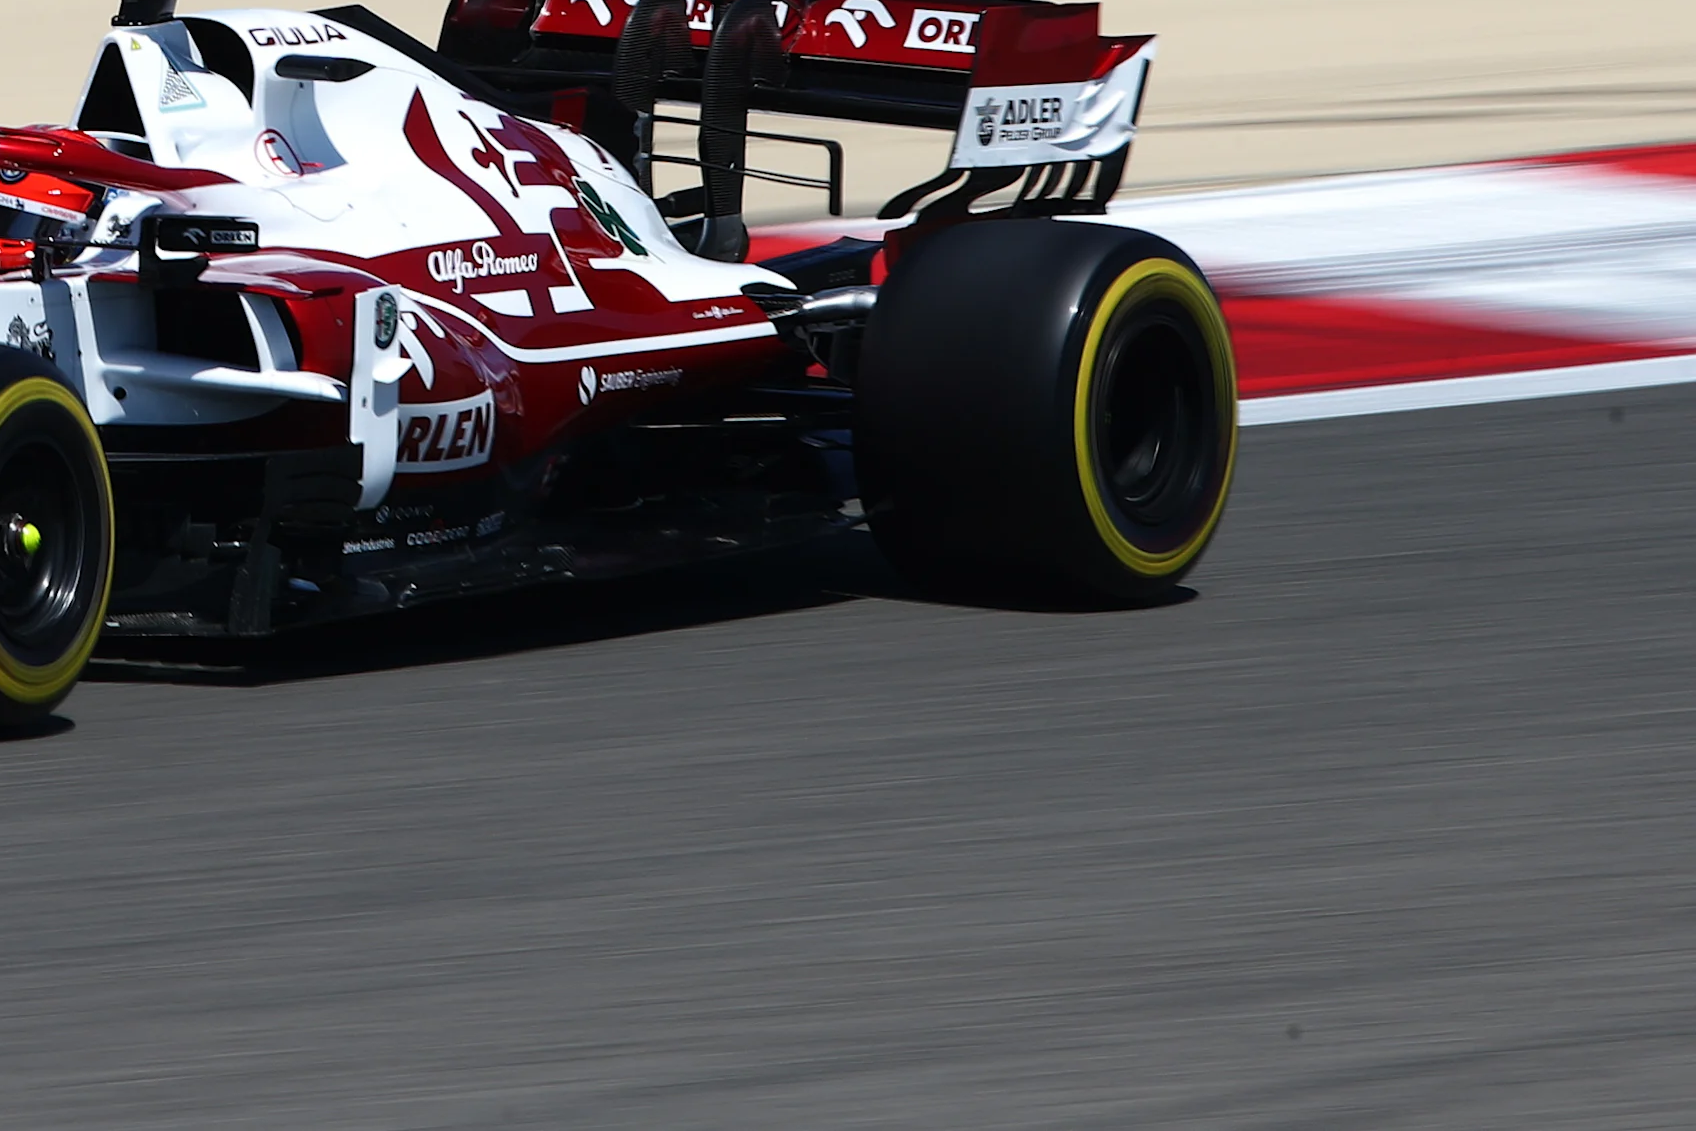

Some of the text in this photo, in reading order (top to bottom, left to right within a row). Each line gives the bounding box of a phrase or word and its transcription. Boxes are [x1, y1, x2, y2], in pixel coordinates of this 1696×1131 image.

[248, 24, 347, 46] GIULIA
[917, 16, 977, 46] ORL
[1001, 97, 1063, 125] ADLER
[427, 241, 538, 294] Alfa Romeo
[600, 371, 635, 392] SAUBER
[397, 401, 491, 463] RLEN
